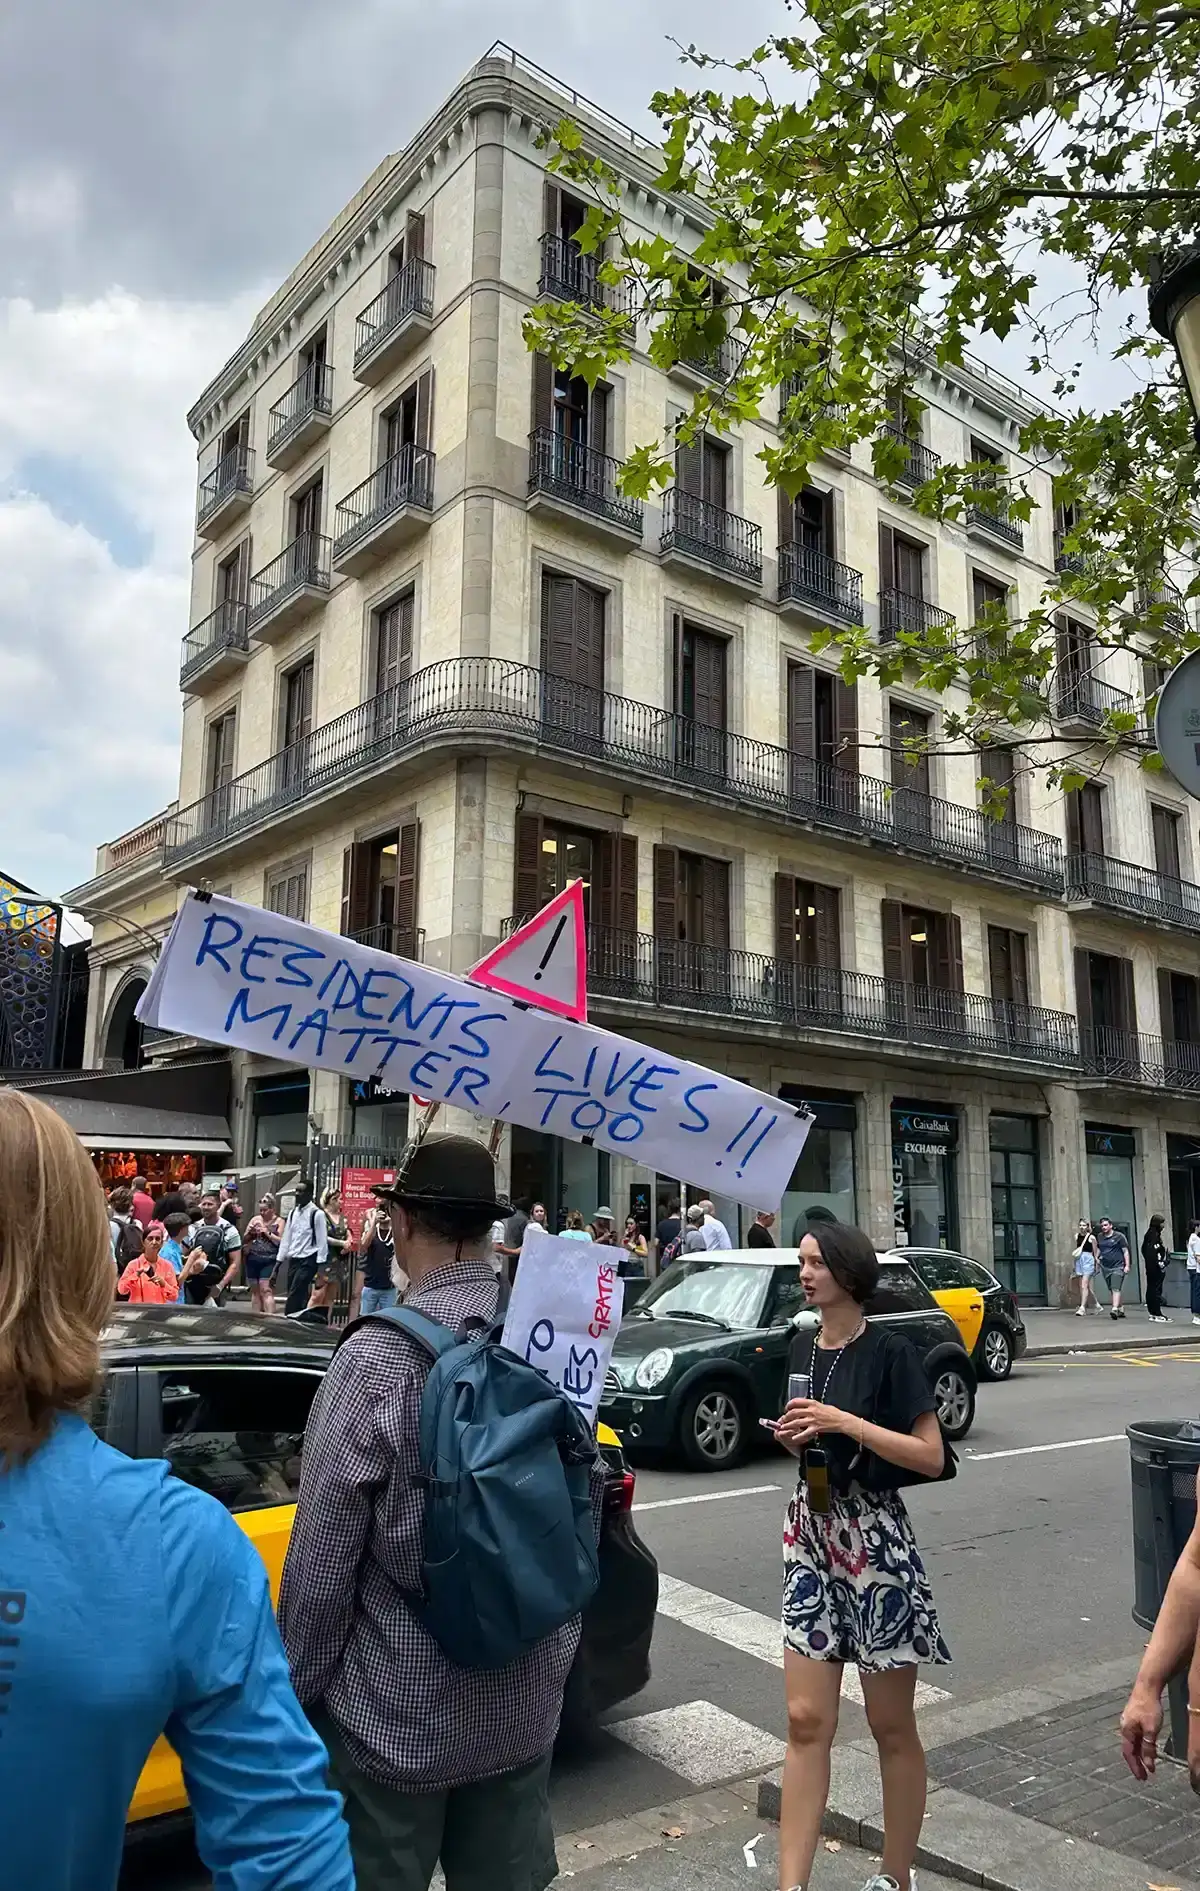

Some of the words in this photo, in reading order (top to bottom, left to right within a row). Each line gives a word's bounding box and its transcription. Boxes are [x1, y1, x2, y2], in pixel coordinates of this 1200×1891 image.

[195, 912, 507, 1058] RESIDENTS
[223, 987, 511, 1115] MATTER,
[533, 1088, 644, 1142] TOO
[913, 1117, 951, 1132] CaixaBank
[904, 1142, 948, 1156] EXCHANGE
[345, 1183, 366, 1192] Mercat
[588, 1264, 614, 1339] GRATIS
